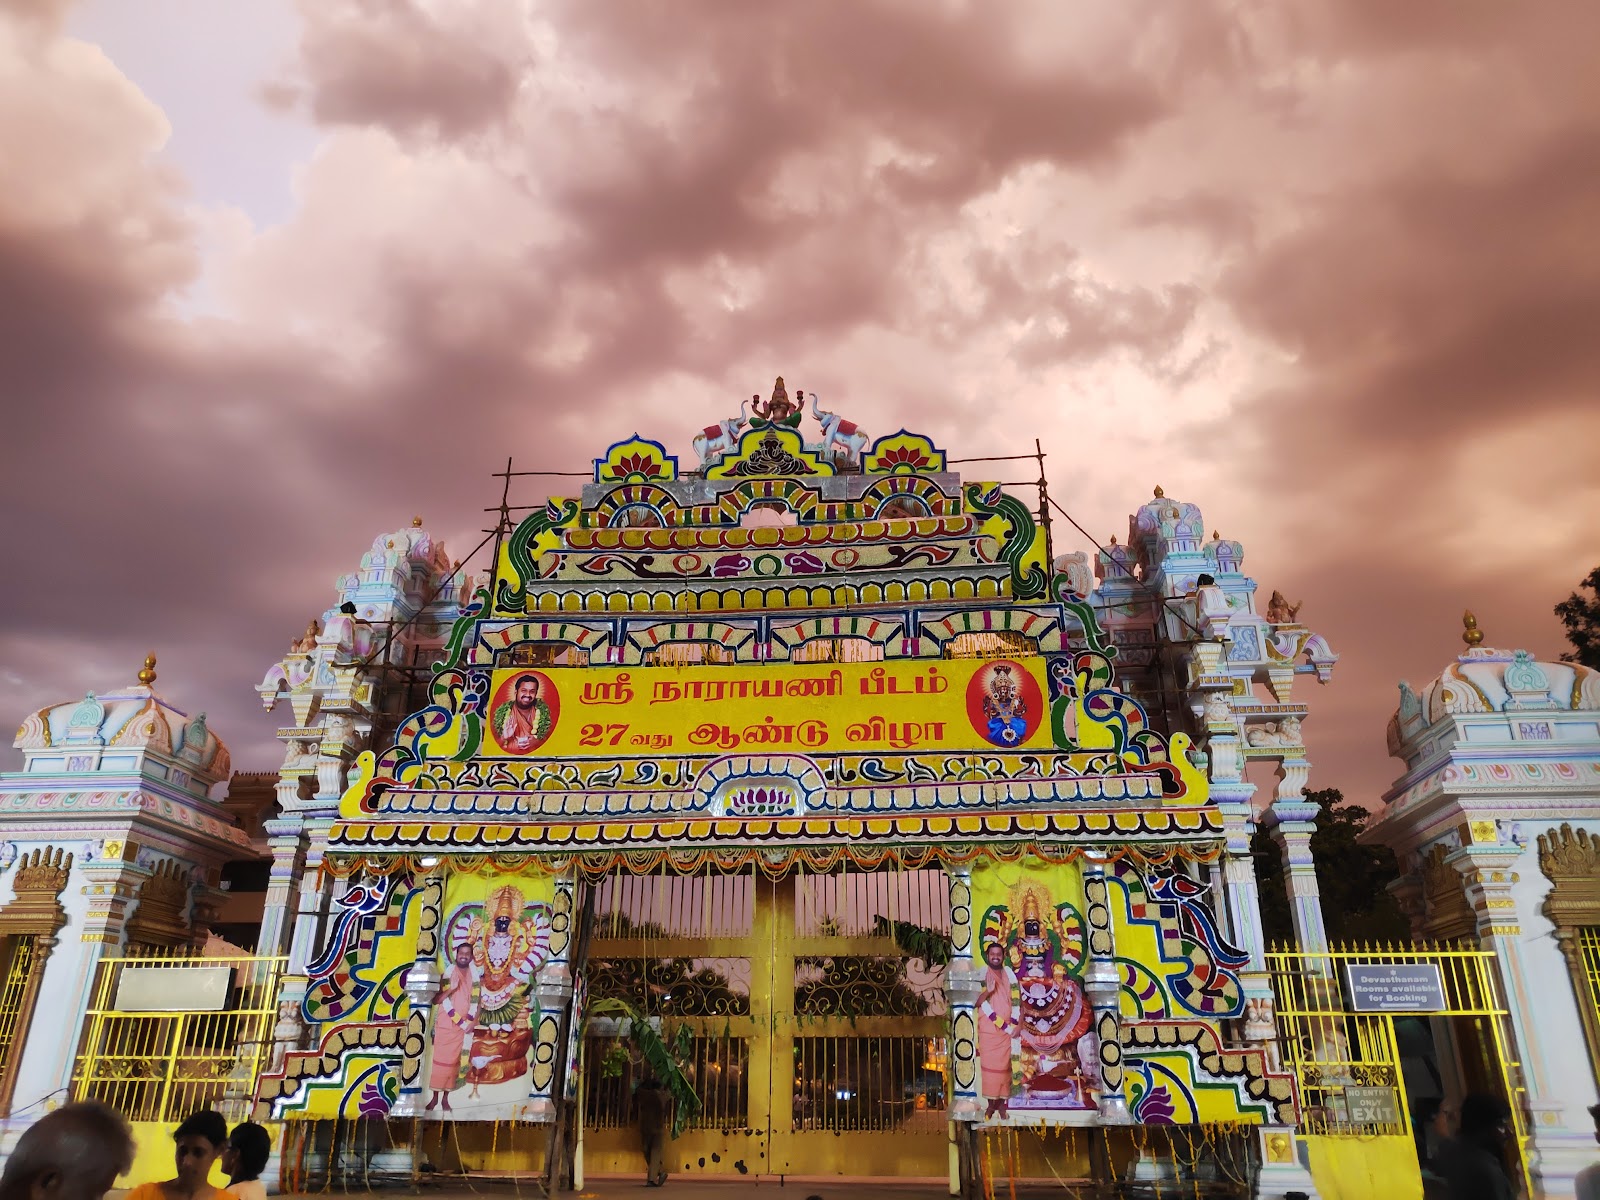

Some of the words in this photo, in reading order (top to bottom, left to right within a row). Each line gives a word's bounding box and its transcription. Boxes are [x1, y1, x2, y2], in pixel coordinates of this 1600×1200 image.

[649, 669, 843, 706] நாராயணி
[859, 666, 949, 695] பீடம்
[578, 723, 673, 750] 27வது
[687, 715, 829, 750] ஆண்டு
[845, 715, 947, 749] விழா
[1360, 976, 1429, 984] Devasthanam
[1355, 985, 1389, 993] Rooms
[1391, 985, 1437, 993] available
[1369, 994, 1383, 1002] for
[1386, 994, 1428, 1003] Booking
[1348, 1089, 1360, 1097] NO
[1362, 1089, 1389, 1097] ENTRY
[1352, 1107, 1393, 1121] EXIT
